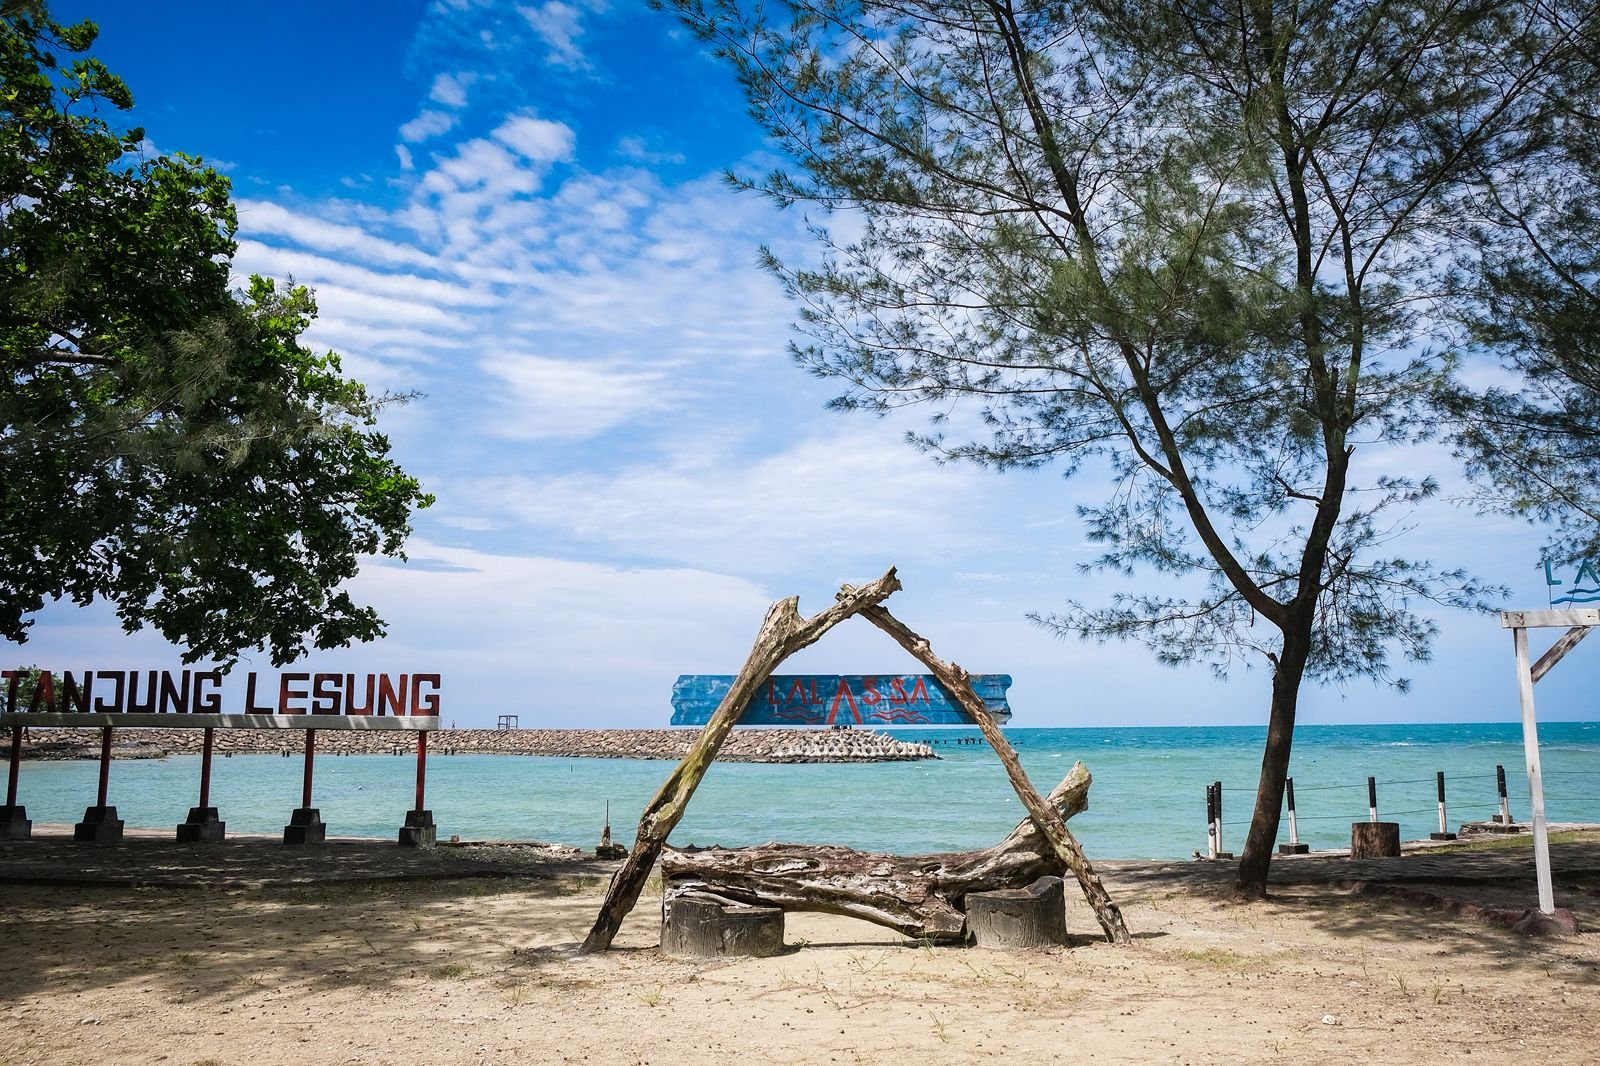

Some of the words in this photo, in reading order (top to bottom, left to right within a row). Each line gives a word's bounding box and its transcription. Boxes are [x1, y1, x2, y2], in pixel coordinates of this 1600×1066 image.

[1, 670, 222, 714] TANJUNG
[244, 672, 441, 716] LESUNG
[768, 677, 930, 724] LALASSA
